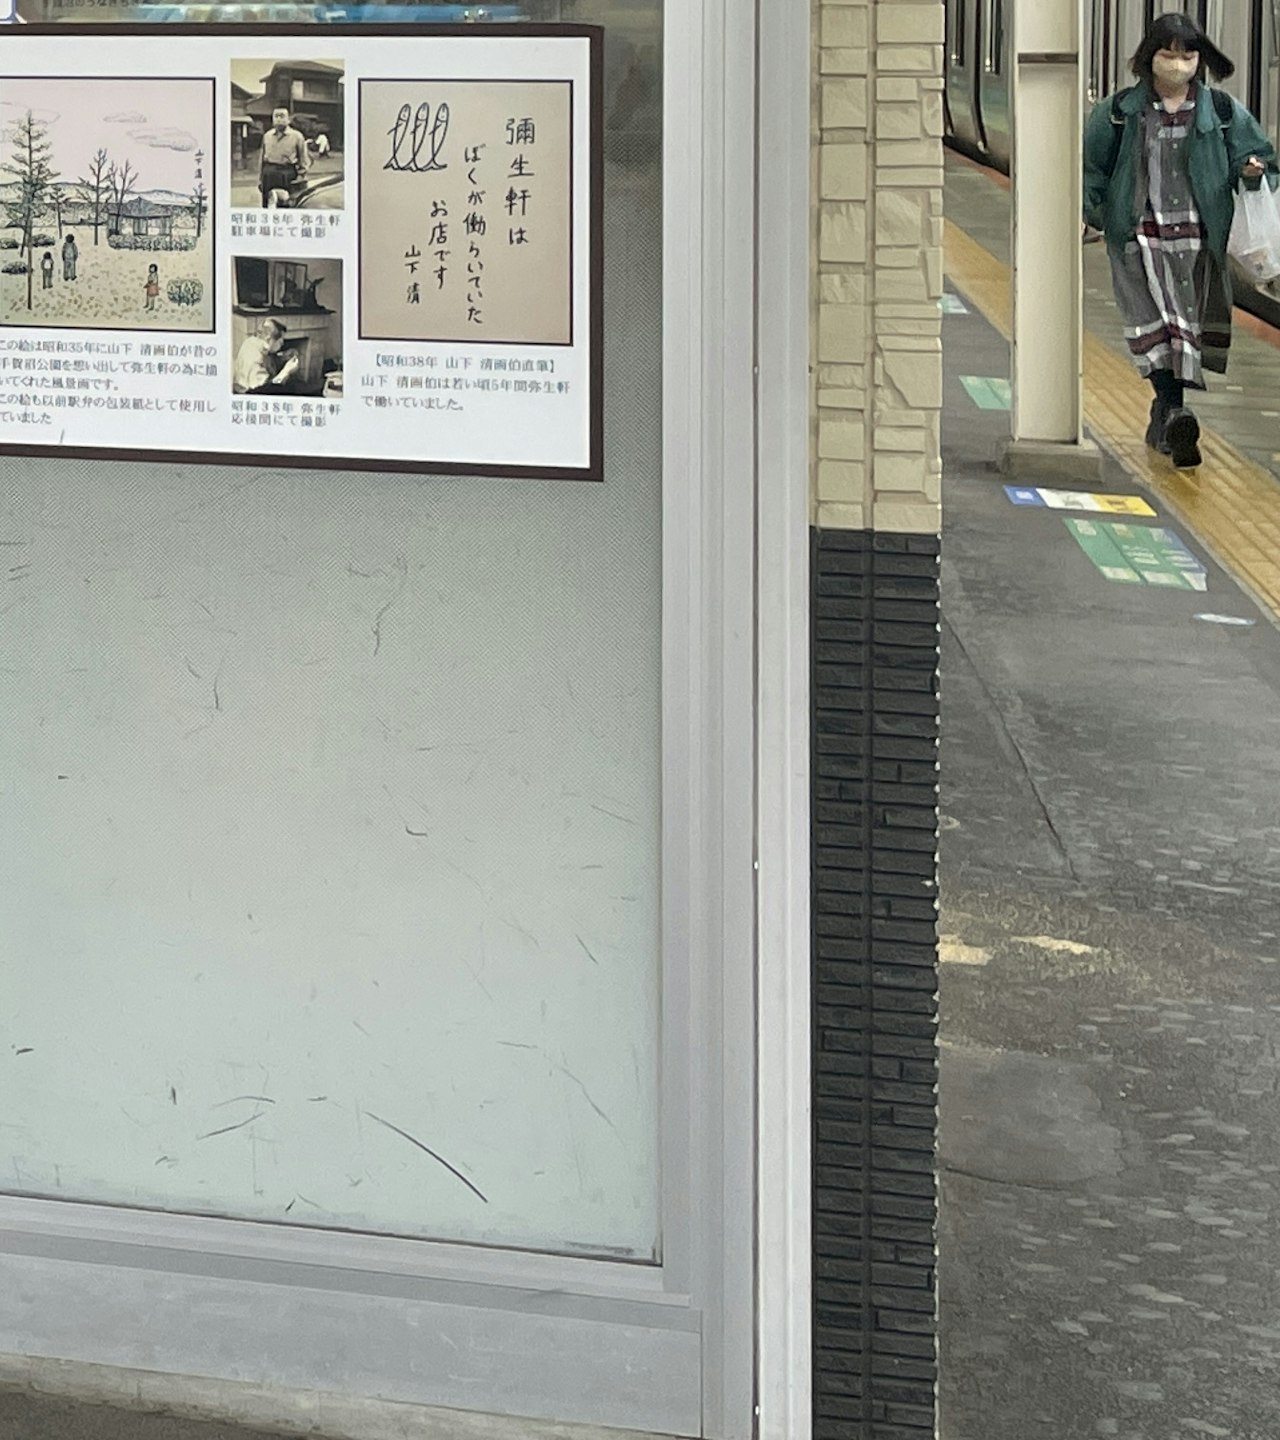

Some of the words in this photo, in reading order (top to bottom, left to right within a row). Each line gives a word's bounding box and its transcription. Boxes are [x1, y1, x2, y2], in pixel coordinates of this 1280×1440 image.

[404, 244, 422, 275] 山下
[428, 200, 452, 290] お店です
[361, 374, 389, 388] 山下
